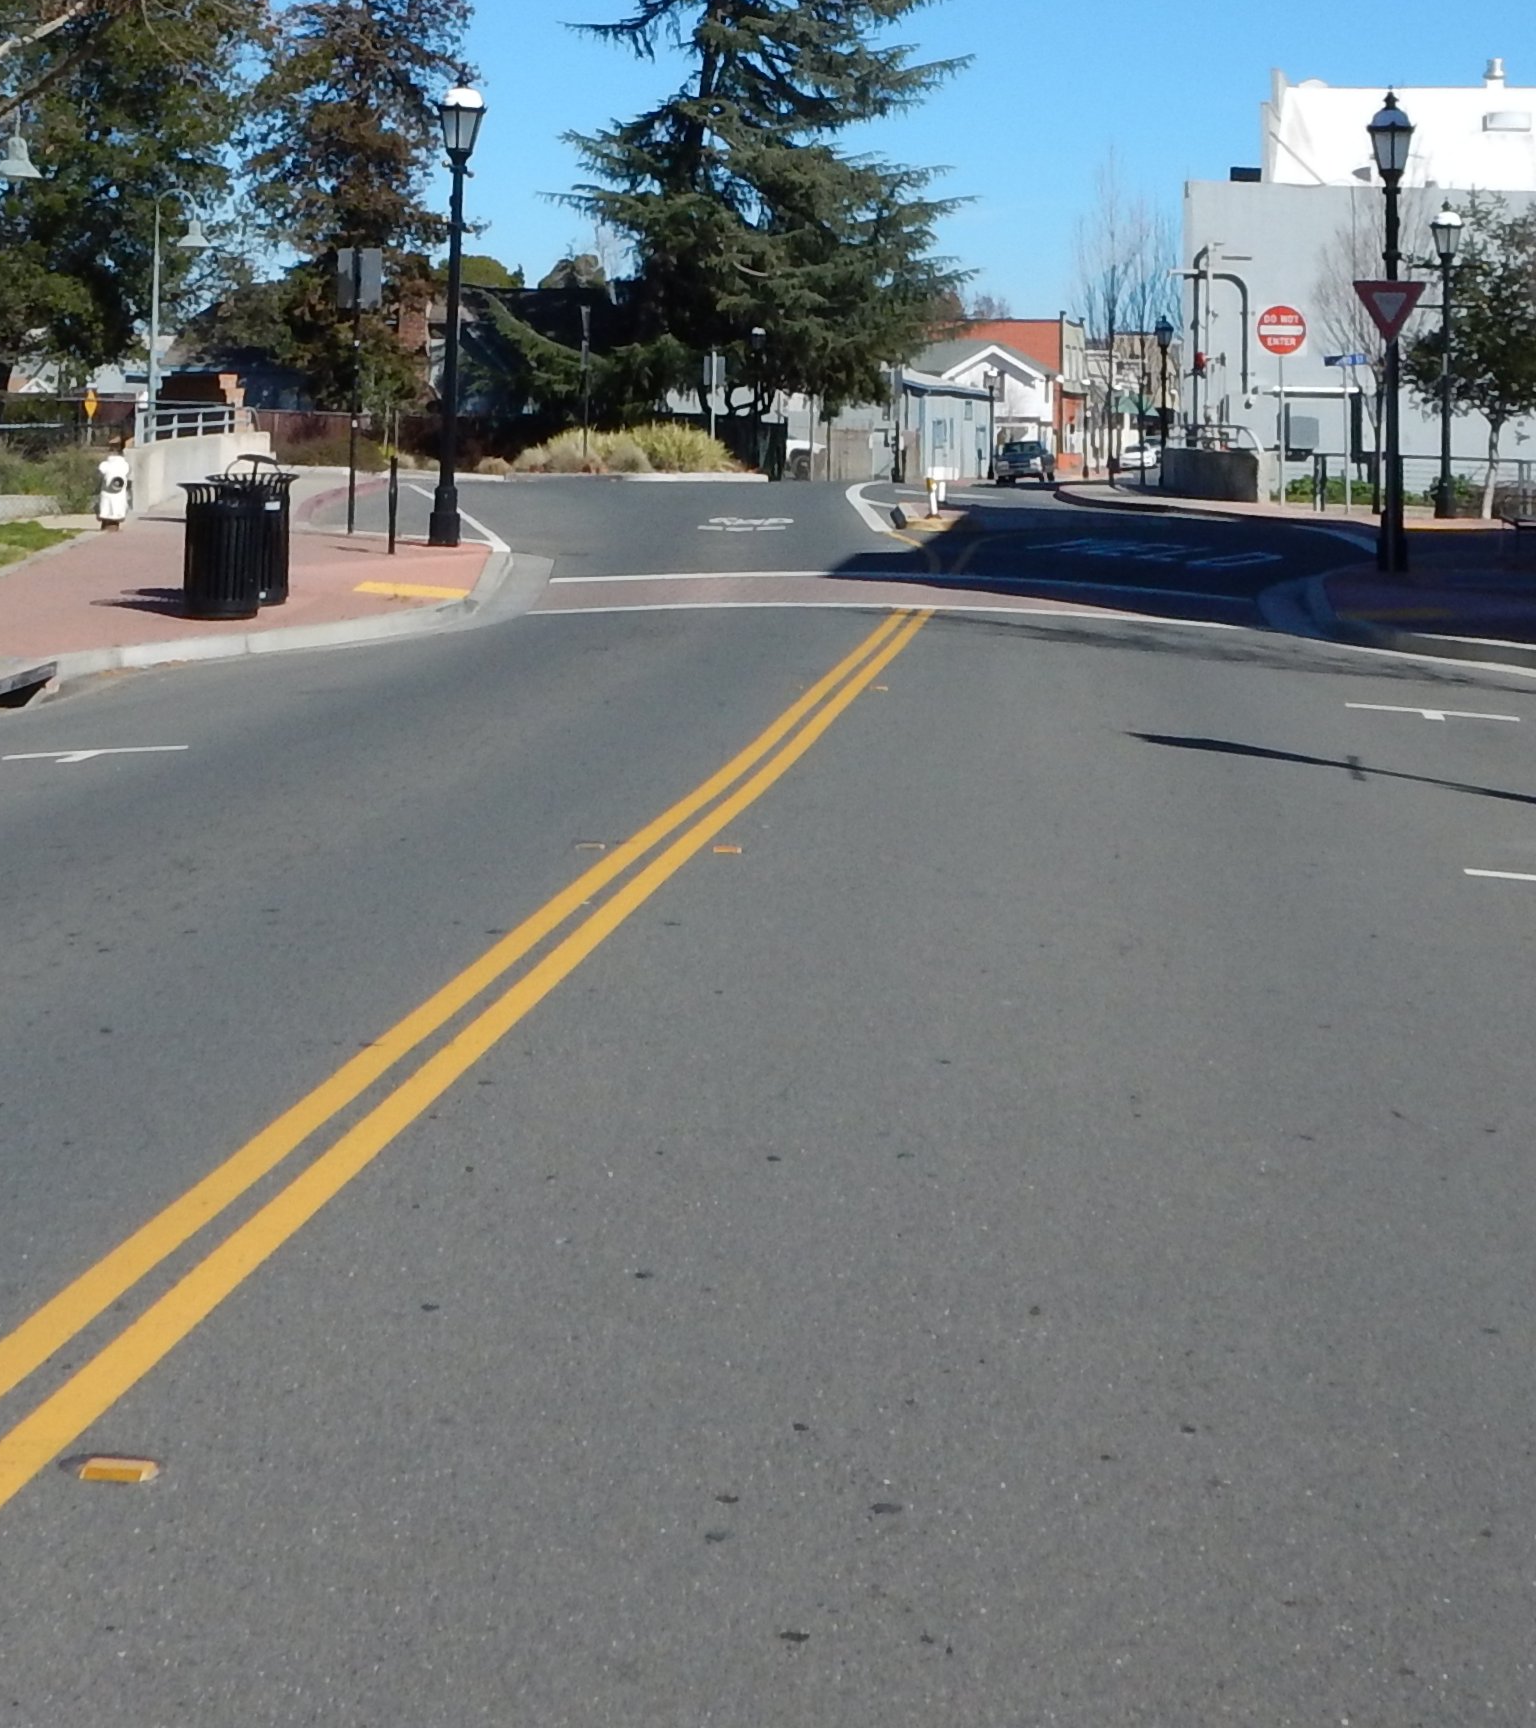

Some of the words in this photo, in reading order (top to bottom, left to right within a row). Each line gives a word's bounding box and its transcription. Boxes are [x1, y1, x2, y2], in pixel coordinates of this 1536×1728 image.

[1263, 314, 1277, 324] DO
[1279, 314, 1299, 324] NOT
[1266, 336, 1296, 346] ENTER
